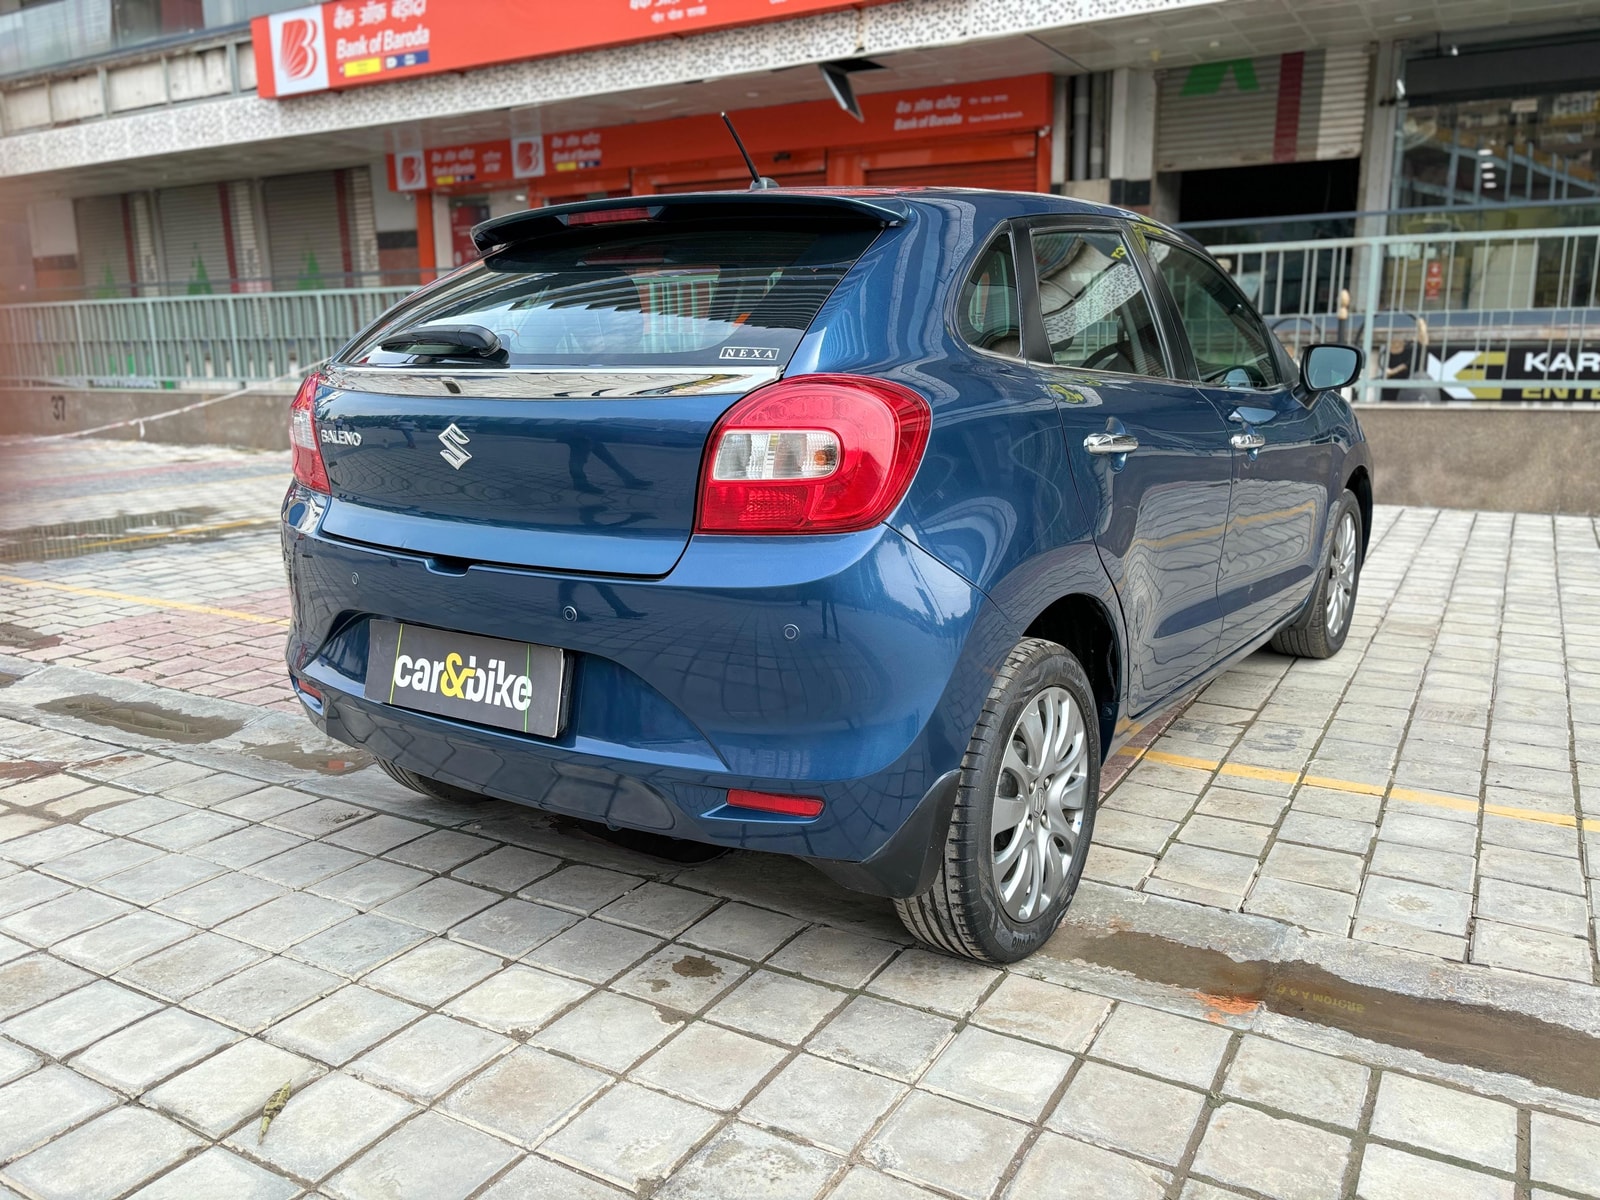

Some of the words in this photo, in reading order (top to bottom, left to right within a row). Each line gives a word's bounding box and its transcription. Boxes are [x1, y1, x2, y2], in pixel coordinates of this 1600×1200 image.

[336, 34, 368, 60] Bank
[369, 30, 382, 54] of
[383, 23, 430, 51] Baroda
[725, 348, 774, 358] NEXA
[51, 395, 66, 421] 37
[321, 429, 362, 447] BALENO
[394, 652, 533, 711] car&bike
